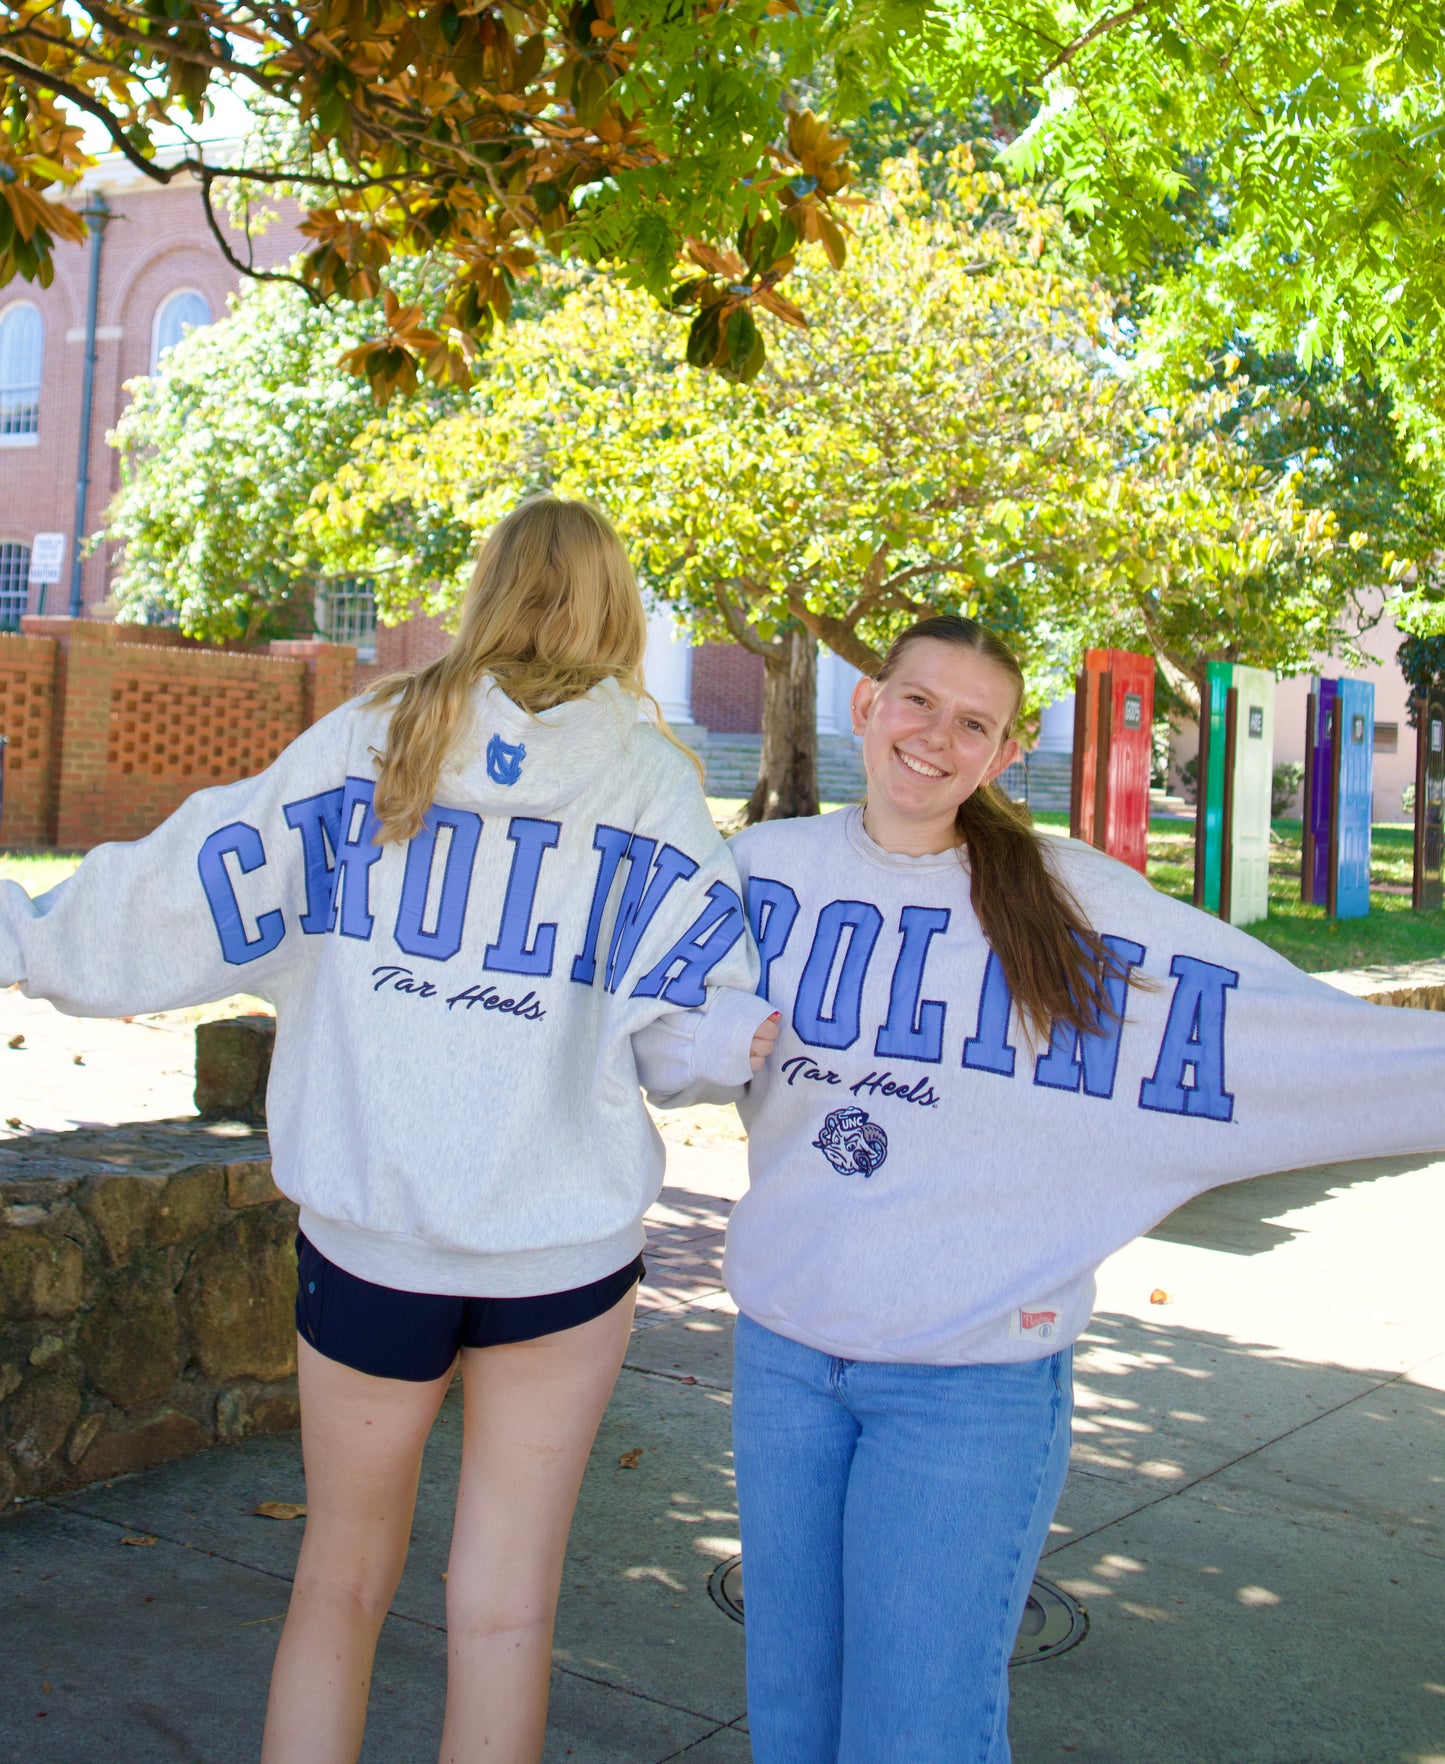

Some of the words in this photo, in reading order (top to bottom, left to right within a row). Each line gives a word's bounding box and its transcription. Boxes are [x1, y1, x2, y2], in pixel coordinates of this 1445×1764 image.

[1251, 713, 1262, 732] ARE
[372, 966, 437, 998] Tar
[446, 985, 547, 1020] Heels
[781, 1056, 842, 1086] Tar
[849, 1071, 940, 1106] Heels
[841, 1116, 863, 1130] UNC
